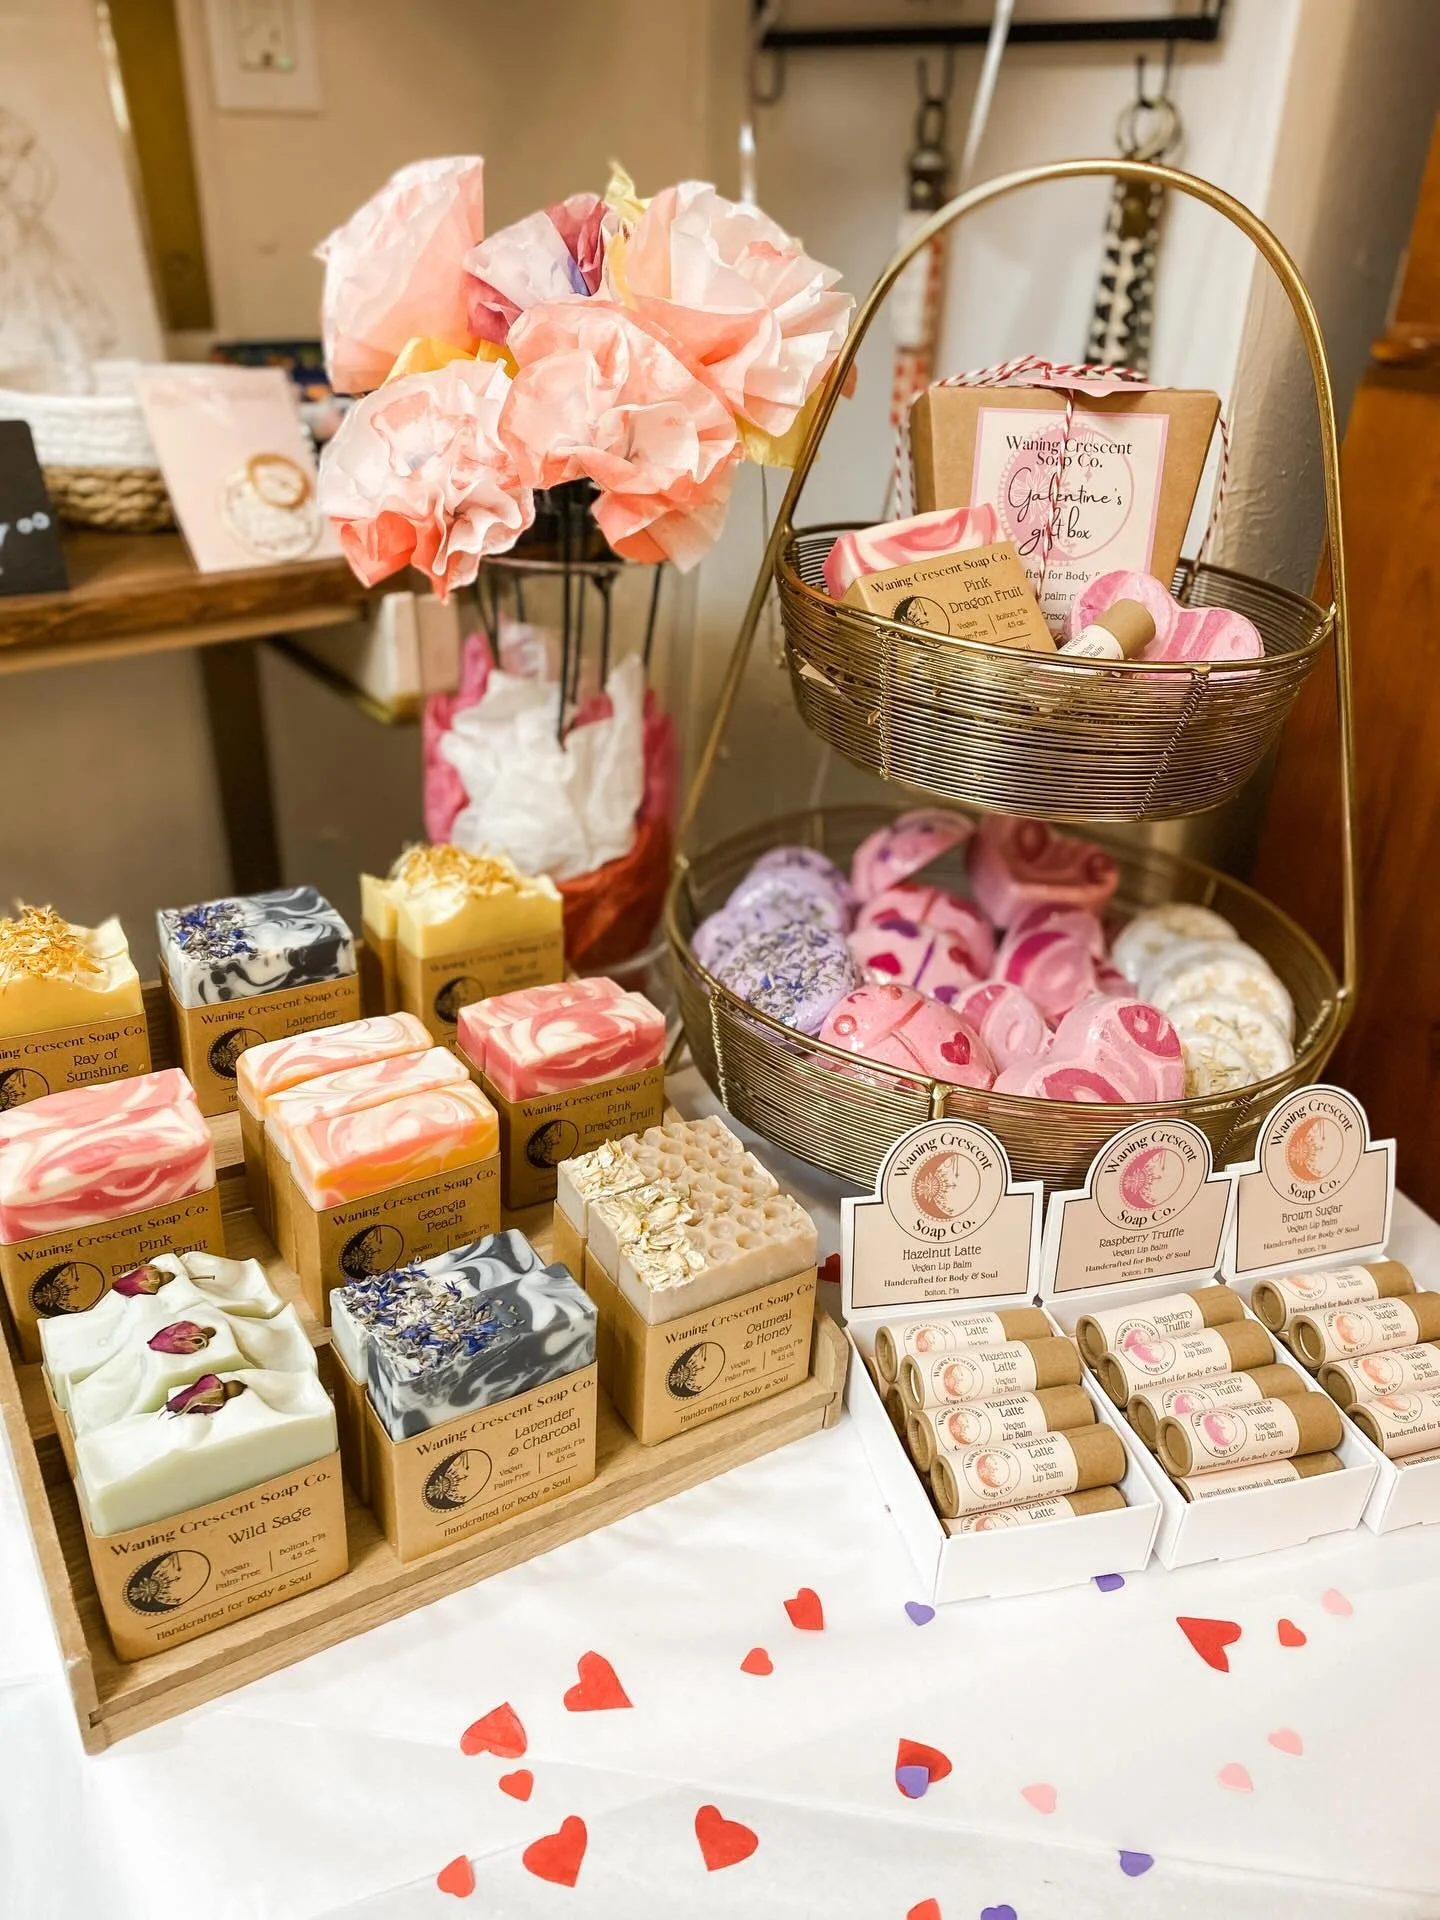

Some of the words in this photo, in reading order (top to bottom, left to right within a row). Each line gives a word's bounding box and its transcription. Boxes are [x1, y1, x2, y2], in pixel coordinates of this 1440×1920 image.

[1006, 436, 1060, 453] Waning
[1064, 438, 1132, 455] Crescent
[1037, 453, 1072, 468] Soap
[1078, 454, 1103, 468] Co.
[1008, 467, 1122, 522] Galentine's
[1018, 506, 1065, 556] gift
[1068, 506, 1091, 539] box
[871, 576, 913, 593] Waning
[913, 565, 963, 582] Crescent
[963, 557, 990, 569] Soap
[992, 552, 1011, 562] Co.
[1049, 566, 1062, 579] for
[963, 577, 992, 592] Pink
[948, 597, 994, 614] Dragon
[995, 586, 1023, 602] Fruit
[201, 1007, 245, 1026] Waning
[248, 999, 300, 1017] Crescent
[303, 992, 333, 1005] Soap
[335, 987, 355, 998] Co.
[286, 1008, 338, 1029] Lavender
[24, 1036, 86, 1055] Crescent
[88, 1029, 121, 1044] Soap
[124, 1025, 145, 1038] Co.
[73, 1051, 99, 1066] Ray
[105, 1048, 119, 1061] of
[66, 1062, 129, 1083] Sunshine
[522, 1102, 564, 1117] Waning
[564, 1089, 614, 1110] Crescent
[616, 1081, 640, 1095] Soap
[642, 1076, 660, 1089] Co.
[607, 1101, 632, 1114] Pink
[584, 1114, 626, 1135] Dragon
[629, 1106, 655, 1120] Fruit
[1270, 1105, 1306, 1146] Waning
[1308, 1099, 1352, 1132] Crescent
[894, 1138, 937, 1176] Waning
[940, 1133, 993, 1170] Crescent
[1105, 1136, 1148, 1173] Waning
[1151, 1130, 1197, 1162] Crescent
[333, 1206, 380, 1225] Waning
[384, 1187, 441, 1209] Crescent
[443, 1176, 473, 1192] Soap
[477, 1169, 497, 1180] Co.
[1288, 1183, 1315, 1201] Soap
[1319, 1180, 1341, 1194] Co.
[418, 1199, 466, 1221] Georgia
[1117, 1210, 1147, 1228] Soap
[1152, 1207, 1175, 1221] Co.
[1282, 1211, 1312, 1223] Brown
[1315, 1204, 1343, 1216] Sugar
[17, 1243, 73, 1262] Waning
[77, 1224, 144, 1248] Crescent
[147, 1213, 181, 1228] Soap
[185, 1206, 209, 1218] Co.
[427, 1215, 463, 1232] Peach
[913, 1219, 946, 1240] Soap
[951, 1220, 976, 1234] Co.
[139, 1234, 173, 1253] Pink
[174, 1239, 208, 1254] Fruit
[1099, 1233, 1149, 1248] Raspberry
[1152, 1228, 1184, 1240] Truffle
[1264, 1237, 1305, 1250] Handcrafted
[903, 1248, 950, 1260] Hazelnut
[955, 1245, 981, 1256] Latte
[1085, 1259, 1132, 1272] Handcrafted
[884, 1276, 934, 1287] Handcrafted
[665, 1322, 708, 1344] Waning
[712, 1303, 764, 1326] Crescent
[767, 1291, 794, 1308] Soap
[797, 1282, 814, 1295] Co.
[747, 1310, 792, 1335] Oatmeal
[1154, 1310, 1193, 1325] Raspberry
[1374, 1309, 1398, 1320] Sugar
[756, 1325, 792, 1345] Honey
[1164, 1320, 1191, 1333] Truffle
[980, 1350, 1022, 1362] Hazelnut
[992, 1361, 1017, 1372] Latte
[1134, 1375, 1175, 1391] Handcrafted
[680, 1401, 728, 1423] Handcrafted
[743, 1385, 763, 1399] Body
[773, 1375, 789, 1386] Soul
[416, 1430, 468, 1456] Waning
[471, 1405, 533, 1434] Crescent
[536, 1390, 568, 1407] Soap
[573, 1379, 595, 1393] Co.
[1243, 1404, 1274, 1417] Truffle
[515, 1407, 575, 1439] Lavender
[1386, 1424, 1426, 1439] Handcrafted
[523, 1418, 581, 1450] Charcoal
[1028, 1446, 1055, 1459] Latte
[1033, 1461, 1057, 1472] Vegan
[110, 1531, 176, 1556] Waning
[180, 1502, 257, 1534] Crescent
[260, 1485, 299, 1504] Soap
[304, 1472, 331, 1487] Co.
[444, 1508, 499, 1536] Handcrafted
[502, 1500, 515, 1512] for
[518, 1490, 539, 1504] Body
[552, 1476, 571, 1490] Soul
[228, 1523, 266, 1545] Wild
[272, 1505, 312, 1529] Sage
[220, 1561, 251, 1578] Vegan
[157, 1608, 223, 1640] Handcrafted
[228, 1600, 242, 1614] for
[247, 1588, 274, 1605] Body
[289, 1572, 312, 1587] Soul
